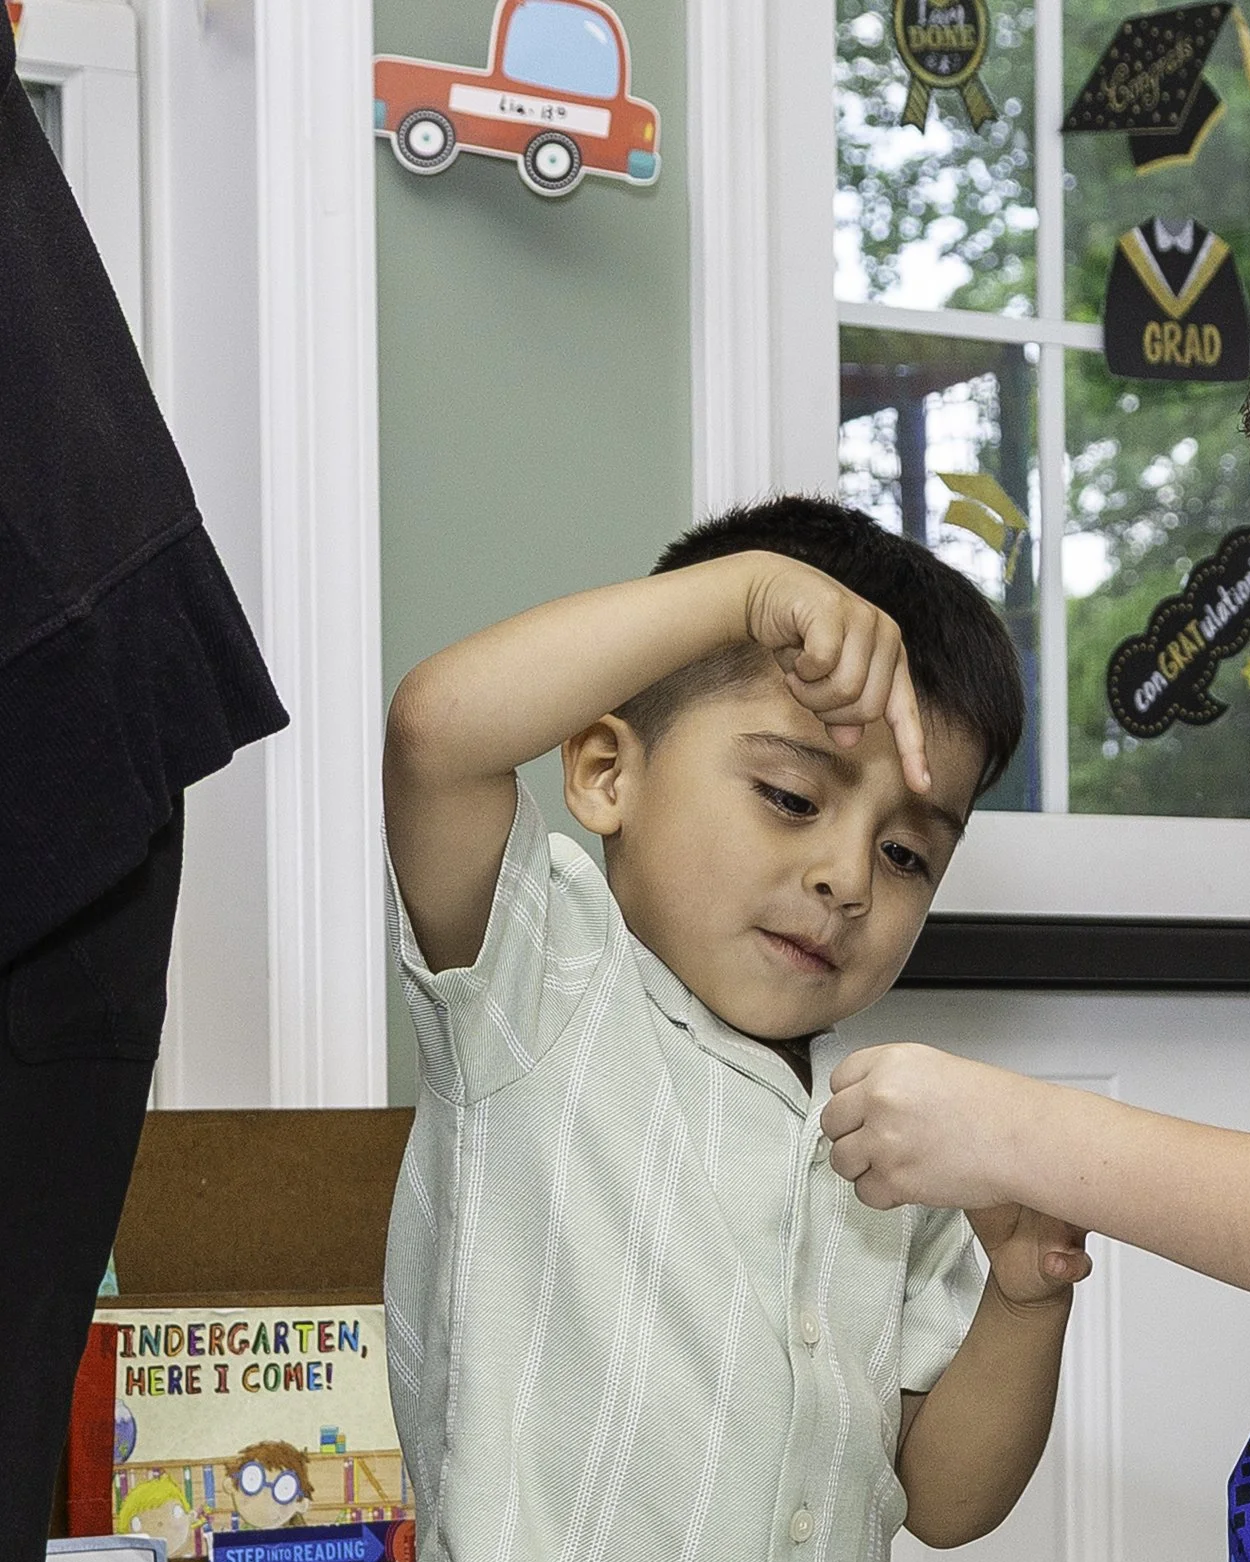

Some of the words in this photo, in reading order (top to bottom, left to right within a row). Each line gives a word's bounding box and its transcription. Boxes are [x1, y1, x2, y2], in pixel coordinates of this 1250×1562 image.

[907, 25, 976, 49] DONE
[1143, 320, 1222, 367] GRAD
[118, 1319, 367, 1358] INDERGARTEN,
[125, 1364, 202, 1396] HERE
[213, 1364, 229, 1393] I
[242, 1361, 333, 1393] COME!
[266, 1548, 292, 1562] INTO
[293, 1540, 365, 1562] READING
